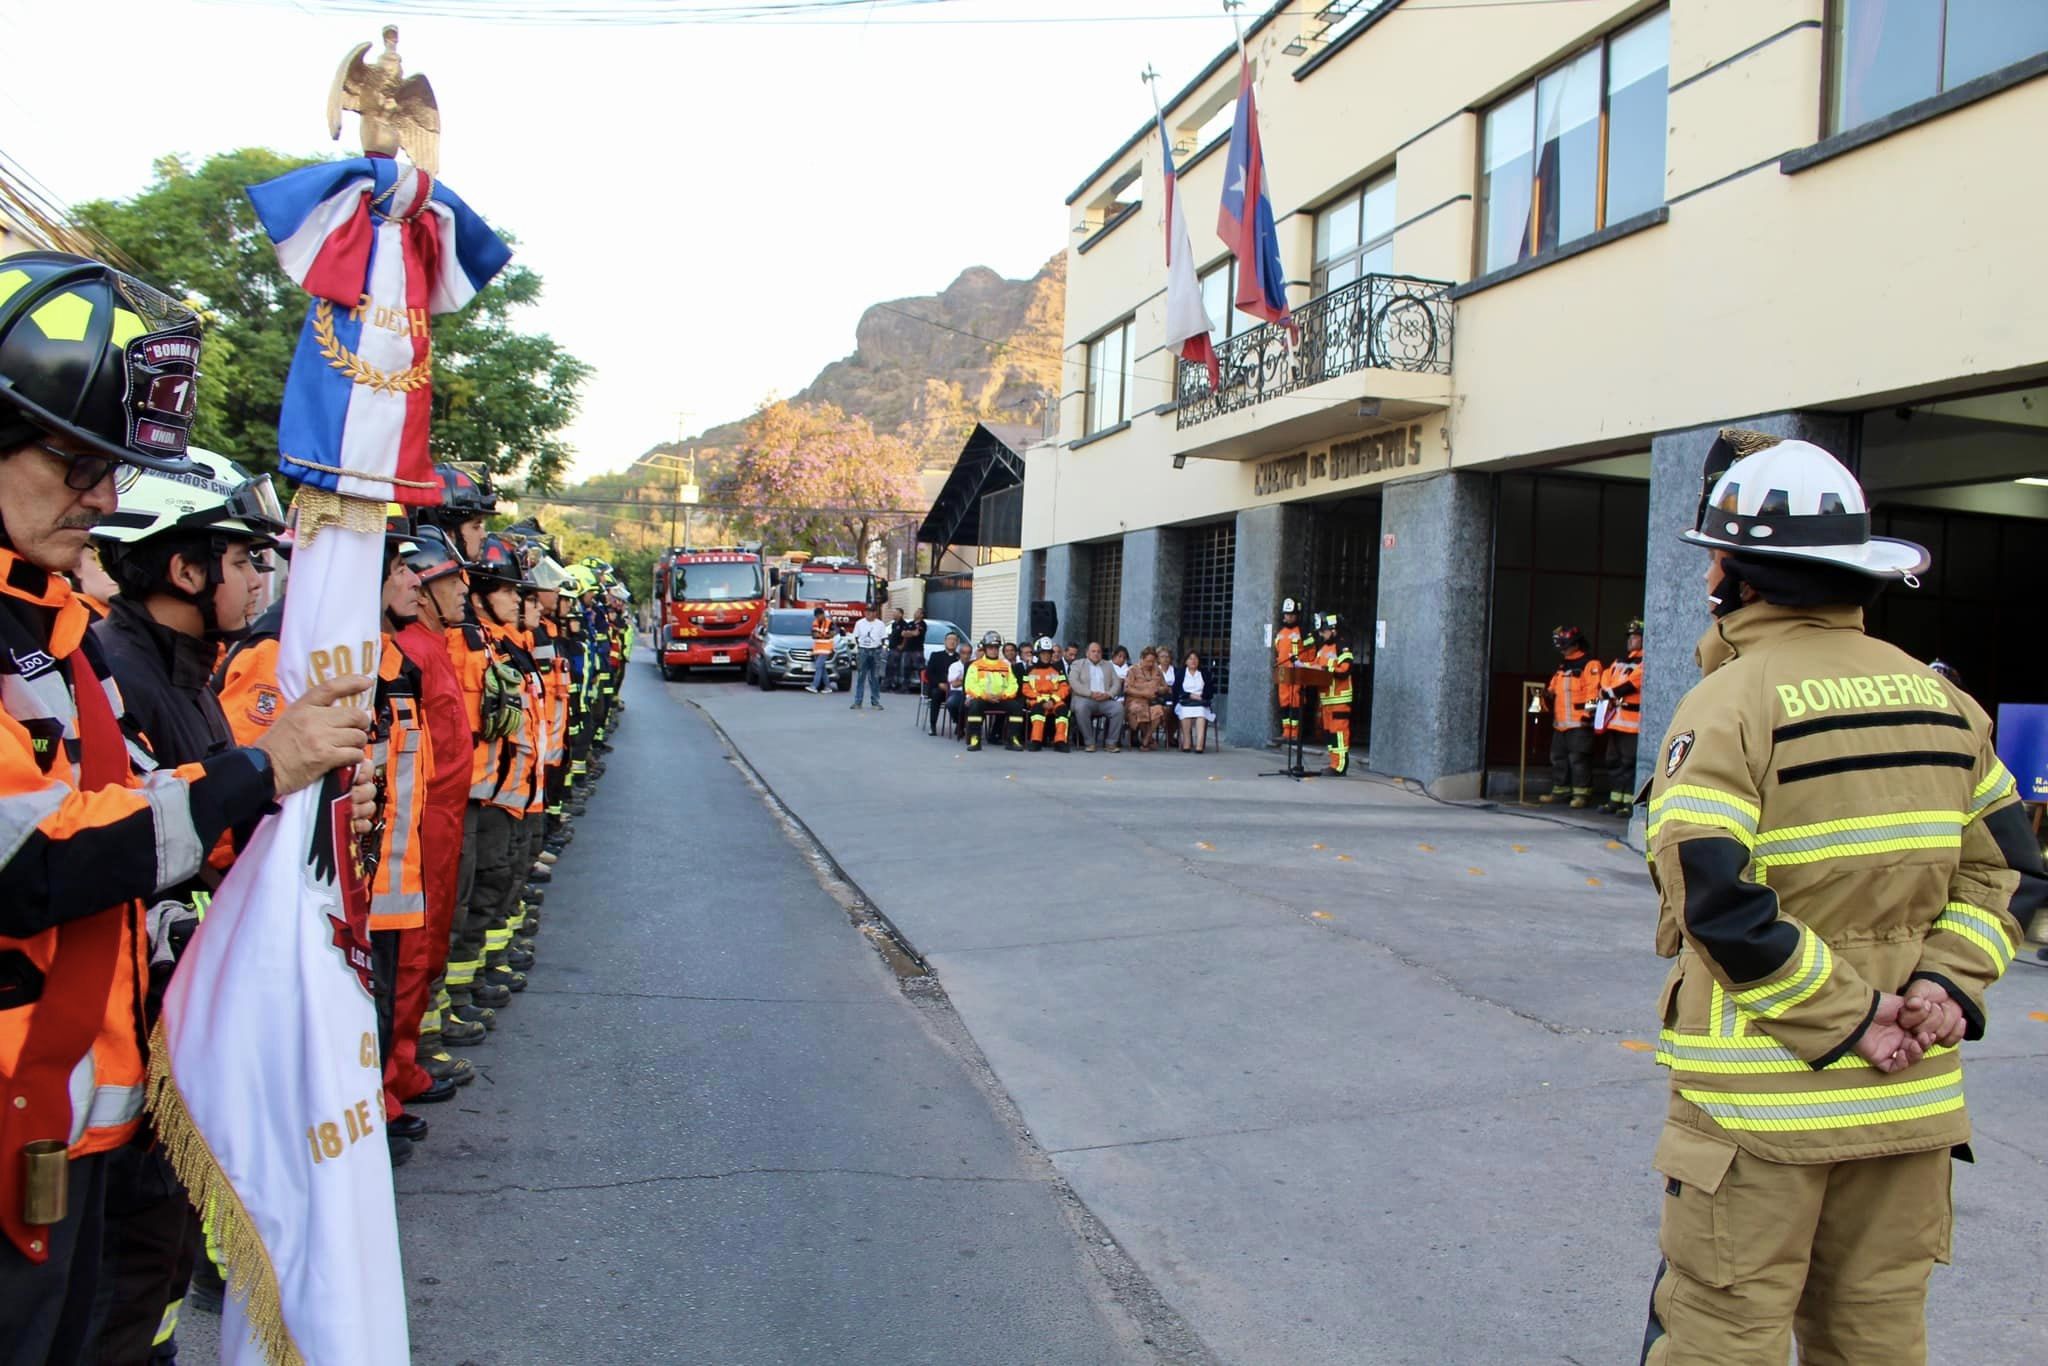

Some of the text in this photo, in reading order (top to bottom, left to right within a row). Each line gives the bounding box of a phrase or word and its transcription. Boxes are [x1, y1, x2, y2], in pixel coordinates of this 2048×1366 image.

[173, 380, 190, 412] 1
[1254, 423, 1423, 496] CUERPO DE BOMBEROS
[307, 644, 353, 689] PO
[1776, 674, 1949, 719] BOMBEROS
[307, 1121, 343, 1164] 18
